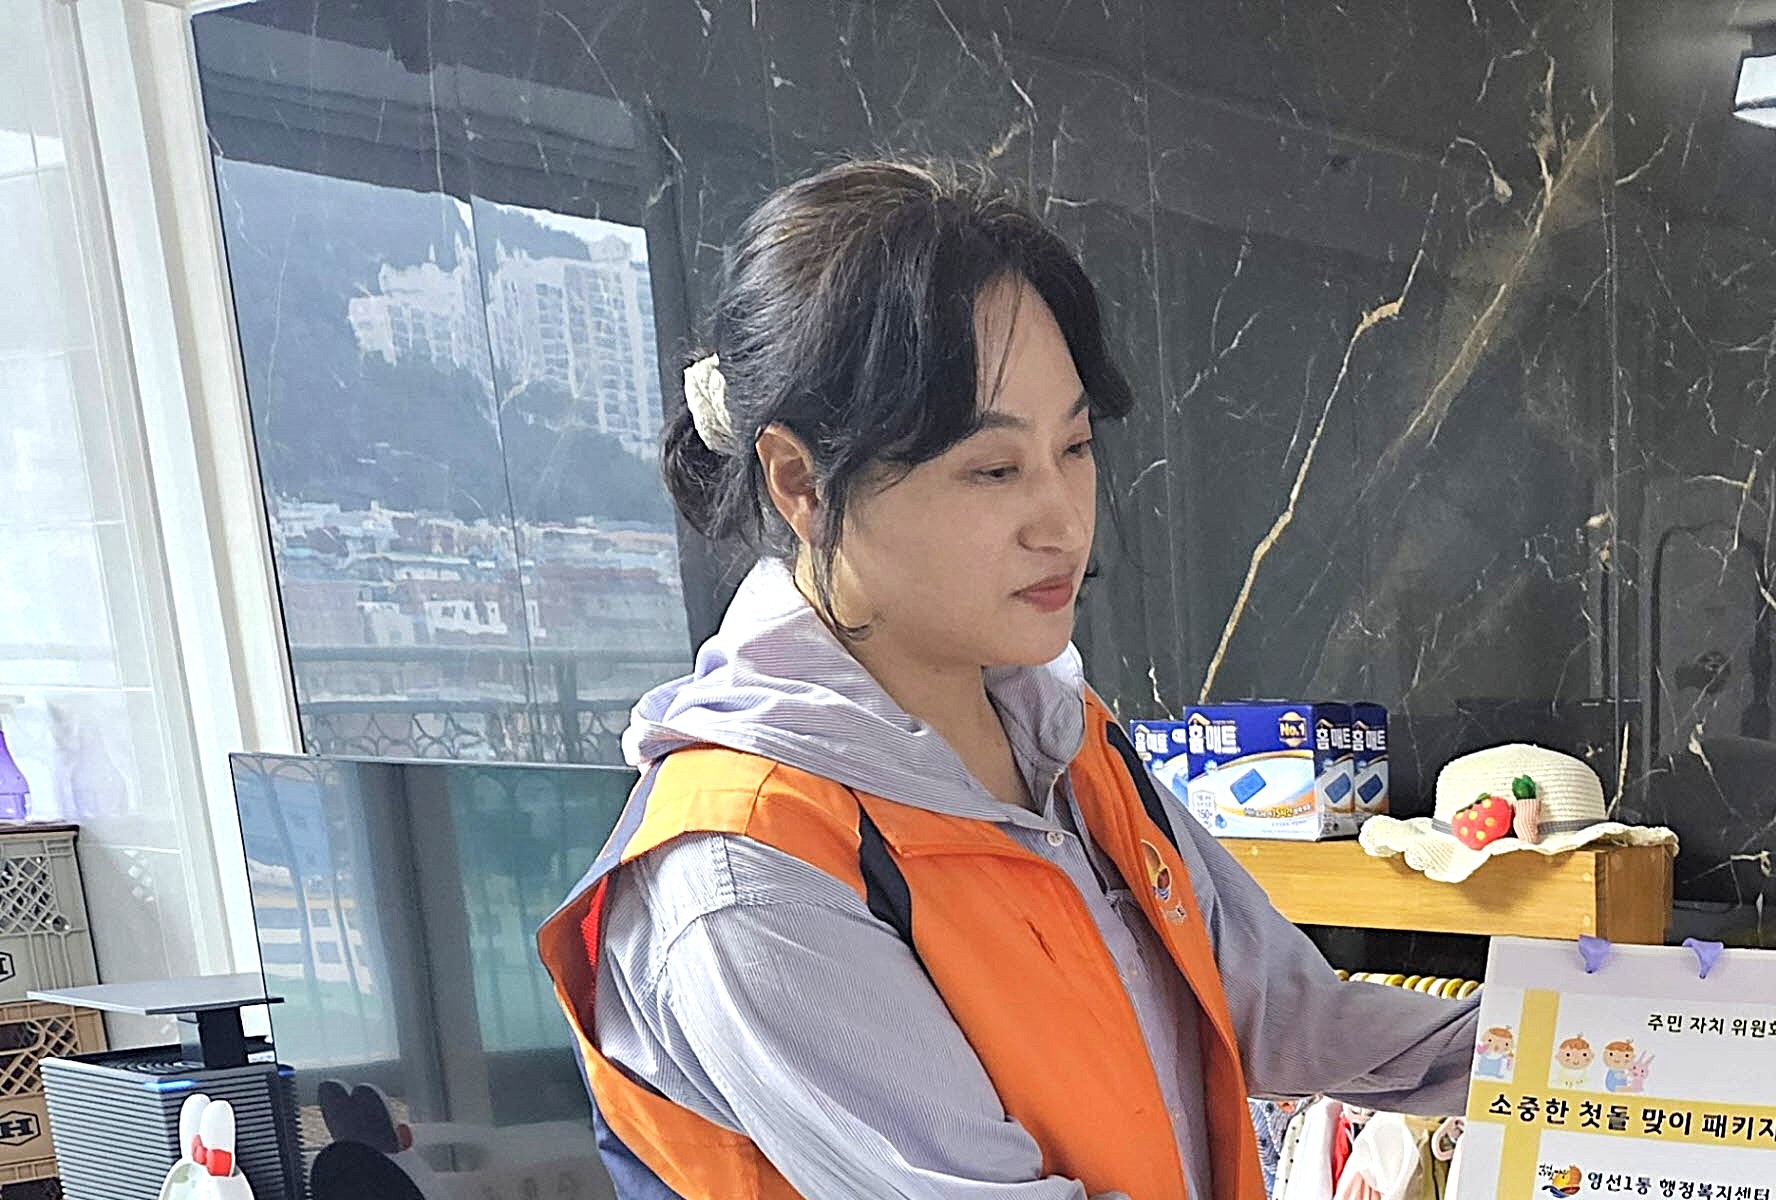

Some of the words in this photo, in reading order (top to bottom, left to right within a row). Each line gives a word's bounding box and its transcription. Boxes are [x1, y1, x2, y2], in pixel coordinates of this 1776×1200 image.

[1188, 714, 1238, 754] 홈매트
[1279, 722, 1305, 737] No.1
[1648, 1014, 1682, 1032] 주민
[1690, 1017, 1724, 1035] 자치
[1489, 1094, 1569, 1124] 소중한
[1579, 1101, 1629, 1131] 첫돌
[1642, 1108, 1691, 1135] 맞이
[1588, 1172, 1651, 1195] 영선1동
